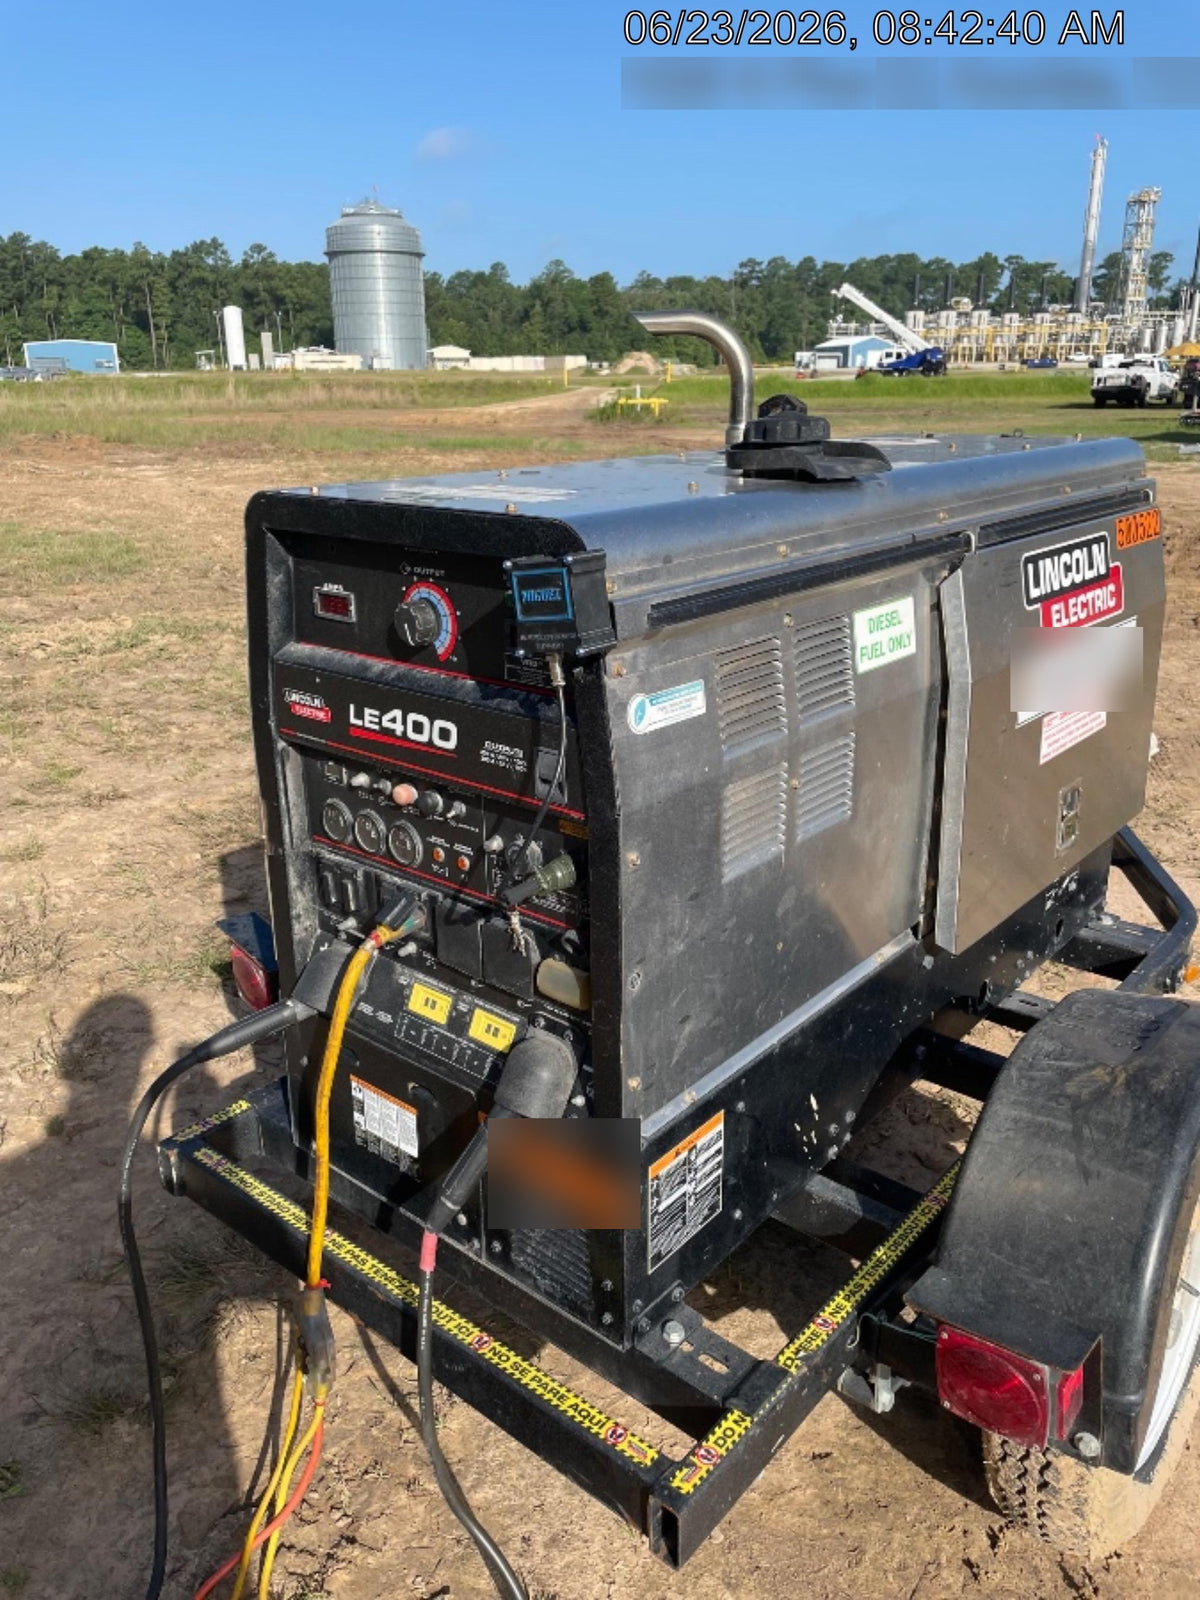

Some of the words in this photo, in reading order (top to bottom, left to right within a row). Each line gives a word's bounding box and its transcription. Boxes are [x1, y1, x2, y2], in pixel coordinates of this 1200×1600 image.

[1027, 542, 1107, 599] LINCOLN
[868, 610, 903, 634] DIESEL
[1050, 583, 1116, 628] ELECTRIC
[860, 641, 886, 664] FUEL
[888, 630, 913, 653] ONLY
[350, 703, 458, 749] LE400
[329, 1237, 348, 1251] NE
[346, 1248, 369, 1267] PAS
[370, 1263, 408, 1295] TENEZ
[456, 1322, 475, 1338] ICI
[829, 1302, 847, 1318] NE
[843, 1282, 865, 1301] PAS
[488, 1347, 511, 1363] NO
[510, 1361, 532, 1377] SE
[529, 1375, 569, 1405] PARE
[714, 1426, 735, 1448] DO
